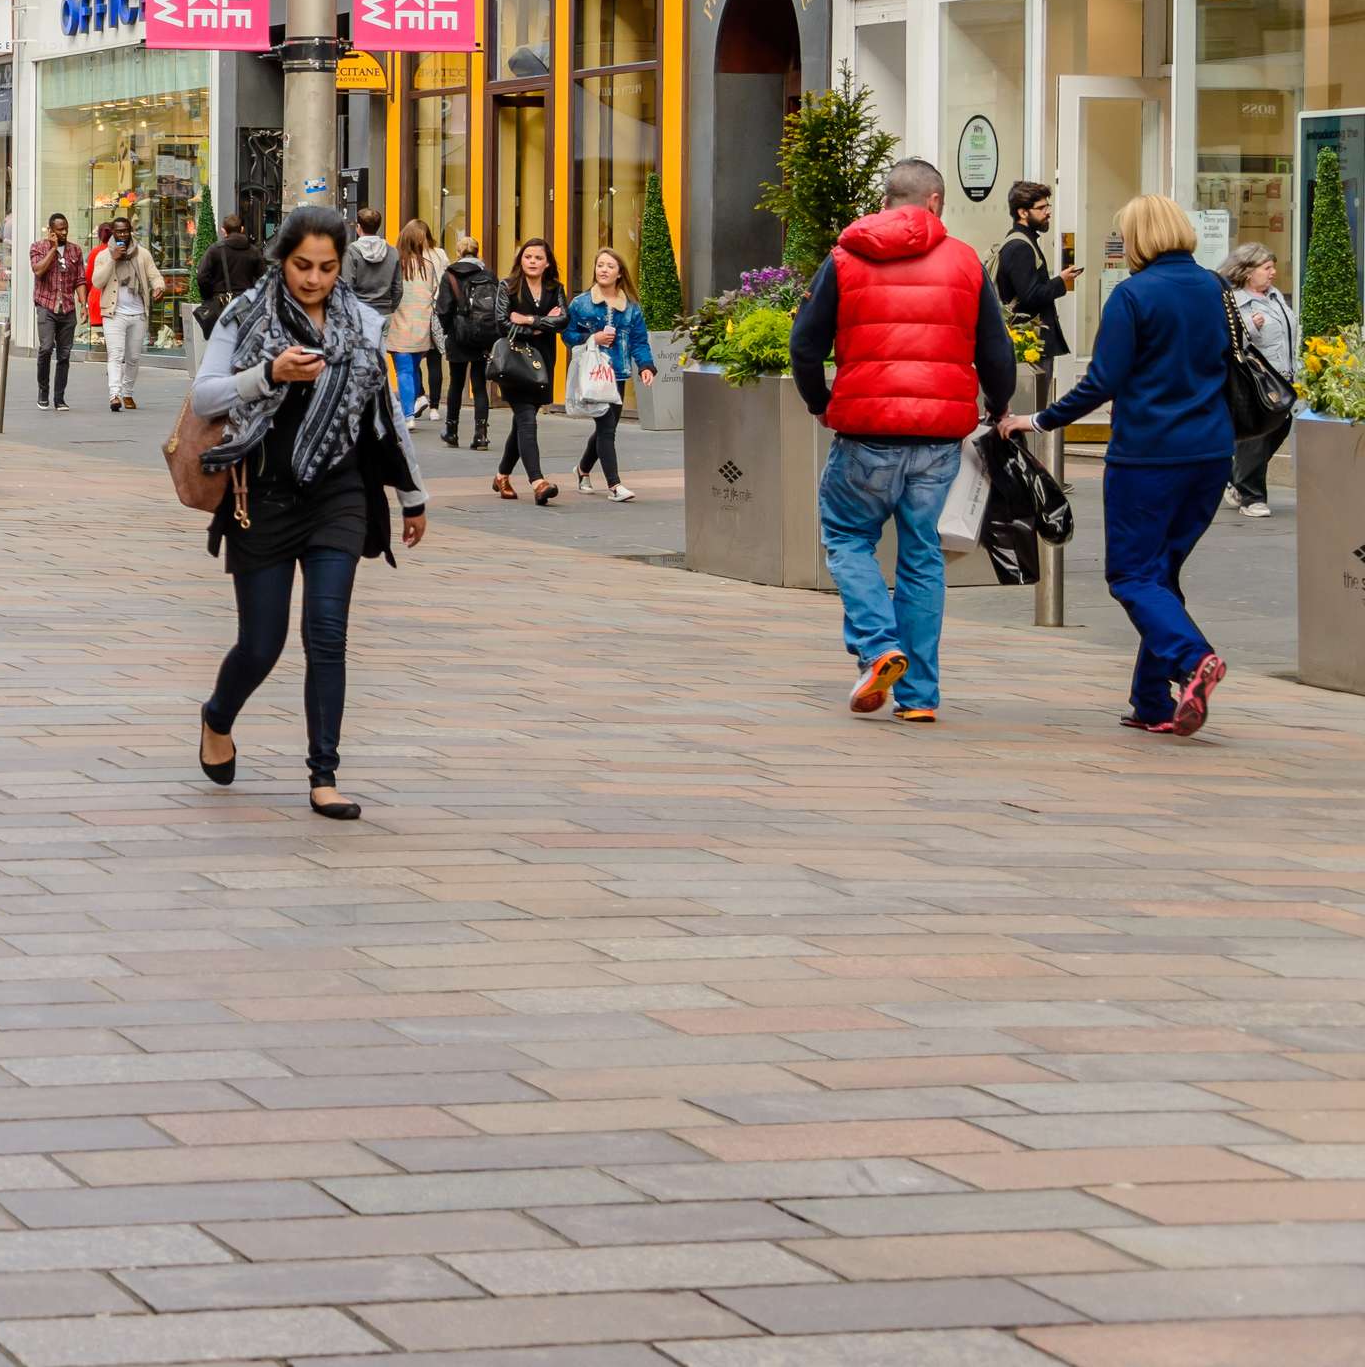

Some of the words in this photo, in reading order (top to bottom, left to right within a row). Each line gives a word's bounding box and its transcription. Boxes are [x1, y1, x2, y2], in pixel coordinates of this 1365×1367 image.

[336, 67, 380, 77] CCITANE
[657, 350, 680, 361] shopp
[589, 362, 615, 383] H&M
